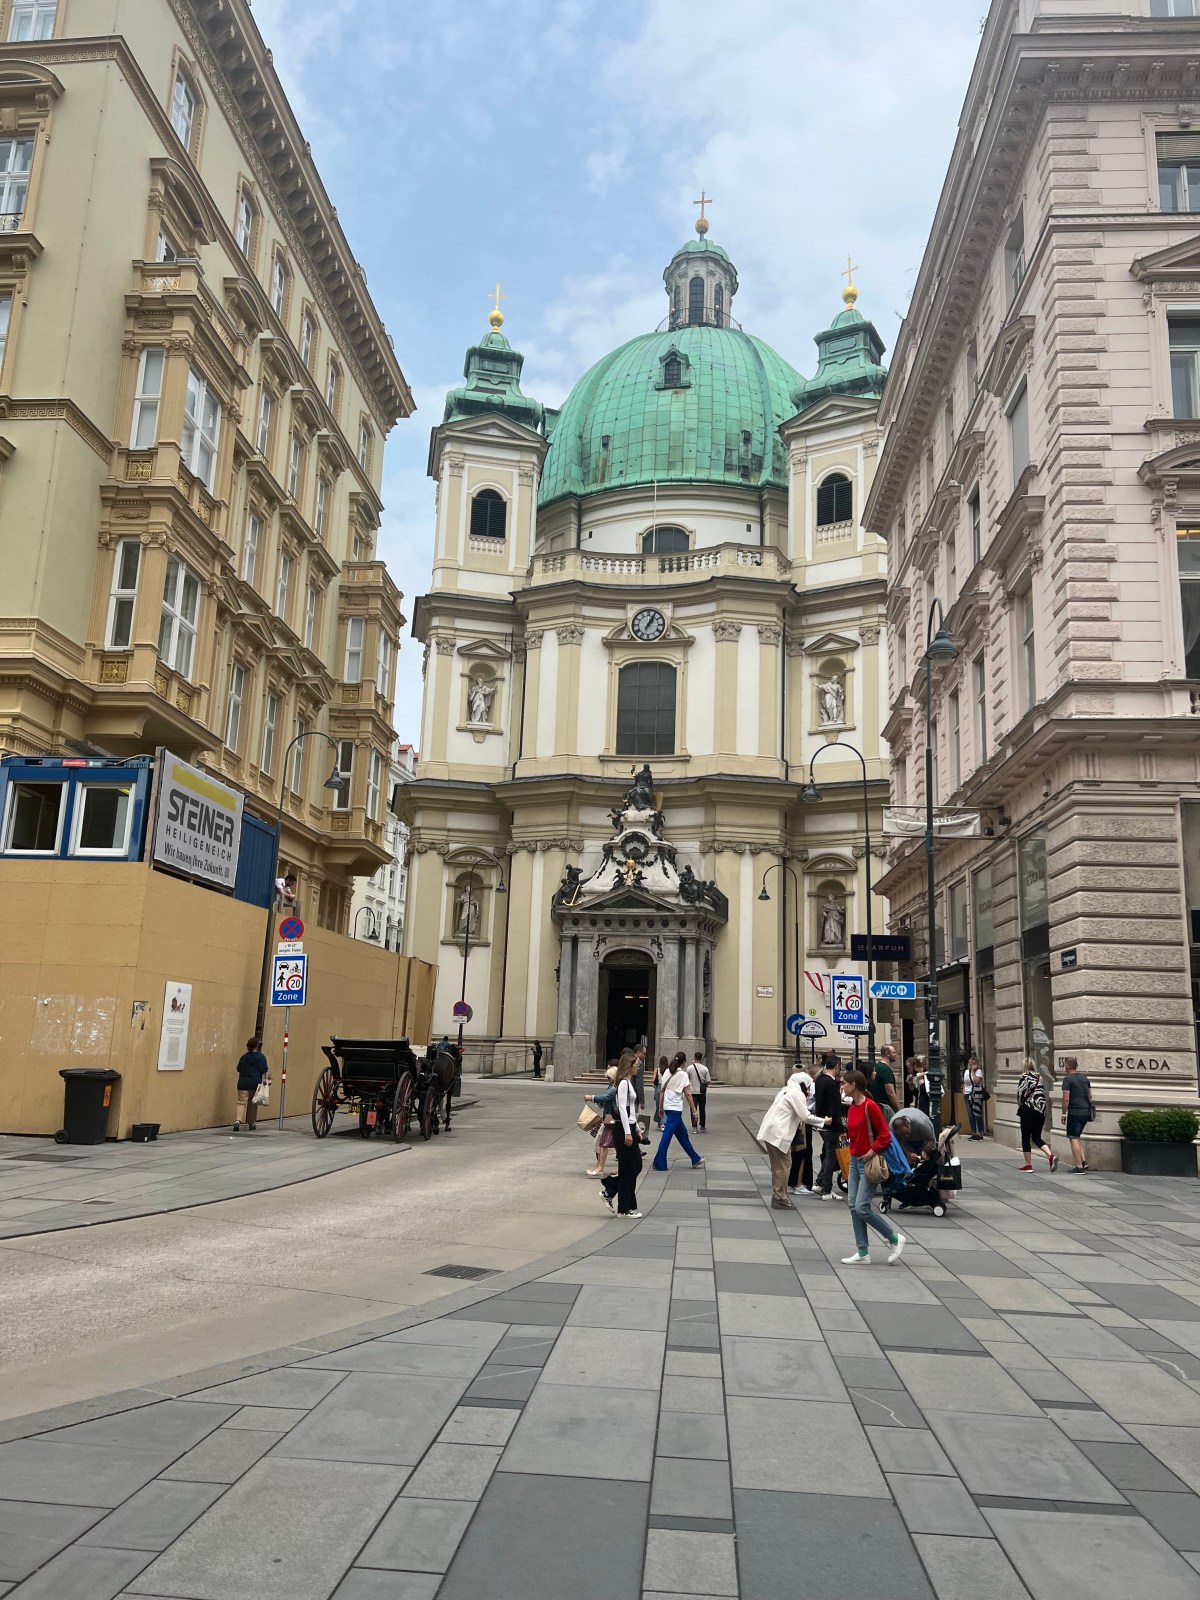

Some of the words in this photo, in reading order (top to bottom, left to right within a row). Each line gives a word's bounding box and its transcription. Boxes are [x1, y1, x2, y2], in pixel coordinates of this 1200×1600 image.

[167, 788, 235, 848] STEINER
[165, 824, 232, 862] HEILIGENEICH
[164, 841, 176, 857] Wir
[176, 846, 192, 865] bauen
[192, 854, 203, 869] Ihre
[203, 859, 224, 877] Zukunft.
[290, 979, 301, 989] 20
[880, 984, 897, 995] WC
[277, 992, 298, 1001] Zone
[849, 999, 860, 1008] 20
[838, 1011, 859, 1021] Zone
[1104, 1056, 1171, 1071] ESCADA
